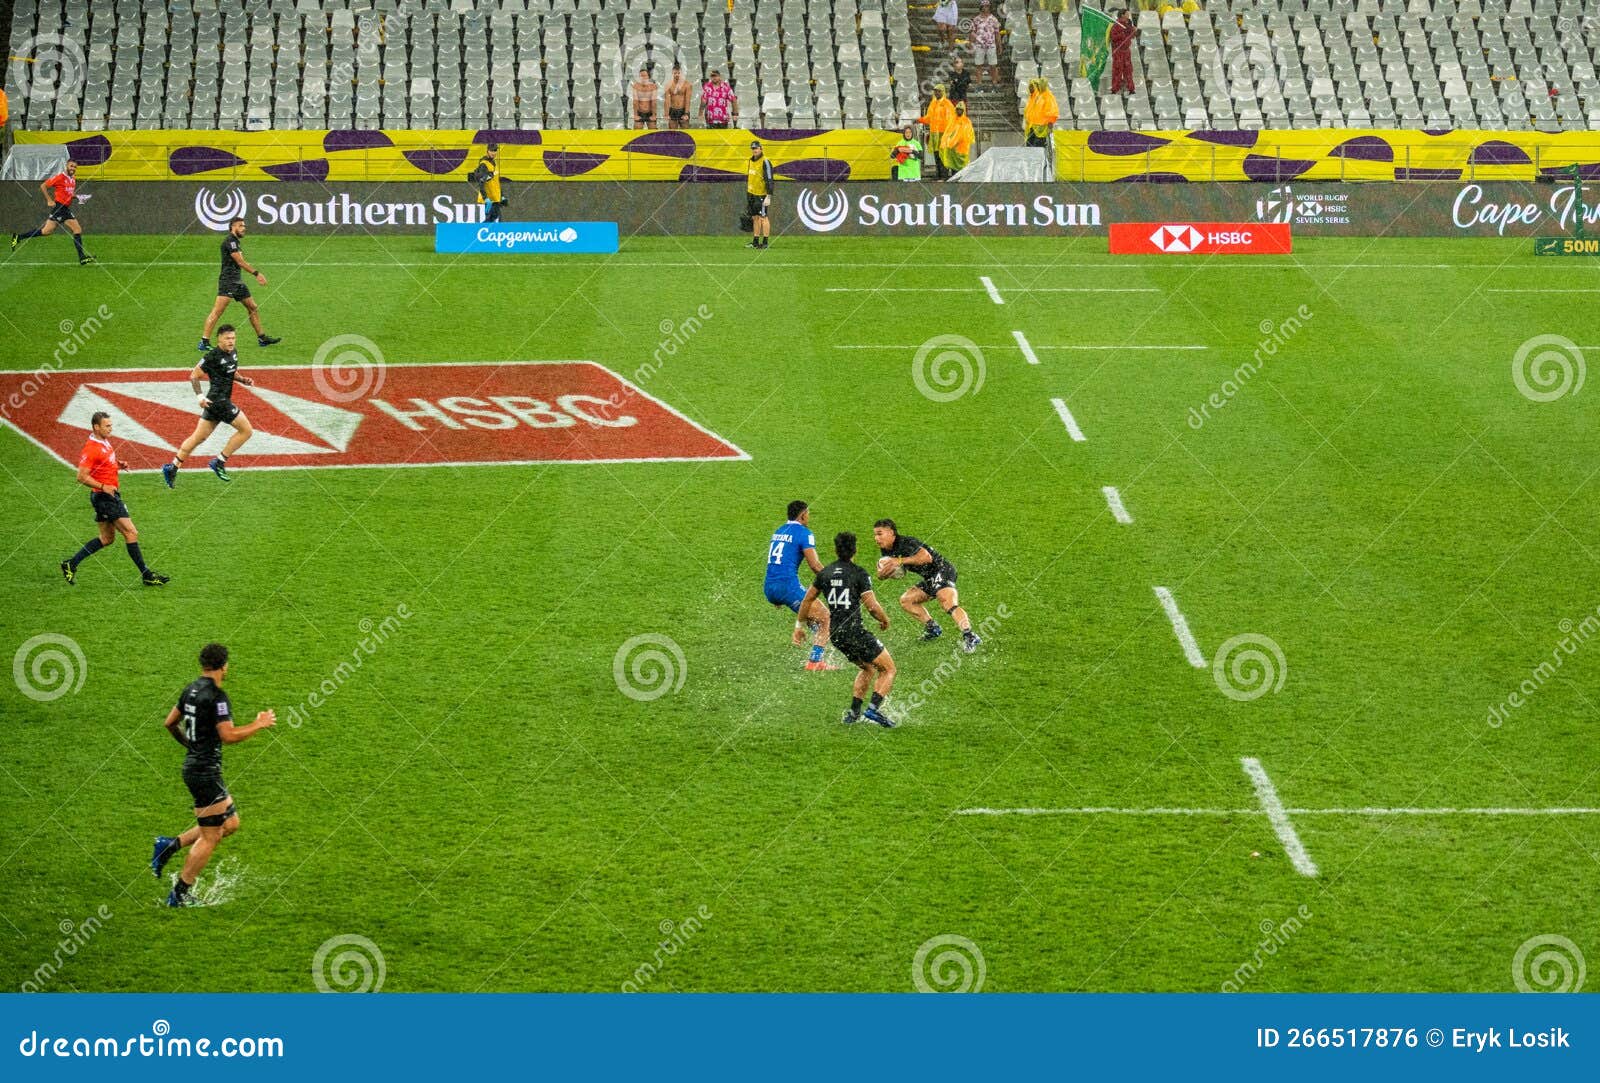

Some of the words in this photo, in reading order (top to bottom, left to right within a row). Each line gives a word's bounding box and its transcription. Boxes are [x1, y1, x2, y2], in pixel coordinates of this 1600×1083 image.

[257, 193, 428, 225] Southern
[858, 194, 1028, 226] Southern
[1033, 195, 1101, 226] Sun
[1295, 216, 1324, 224] SEVENS
[1325, 216, 1351, 224] SERIES
[1324, 205, 1347, 213] HSBC
[1453, 184, 1542, 236] Cape
[477, 227, 558, 248] Capgemini
[1208, 232, 1252, 245] HSBC
[1563, 240, 1599, 253] 50M
[368, 394, 638, 430] HSBC
[767, 541, 785, 565] 14
[827, 587, 852, 609] 44
